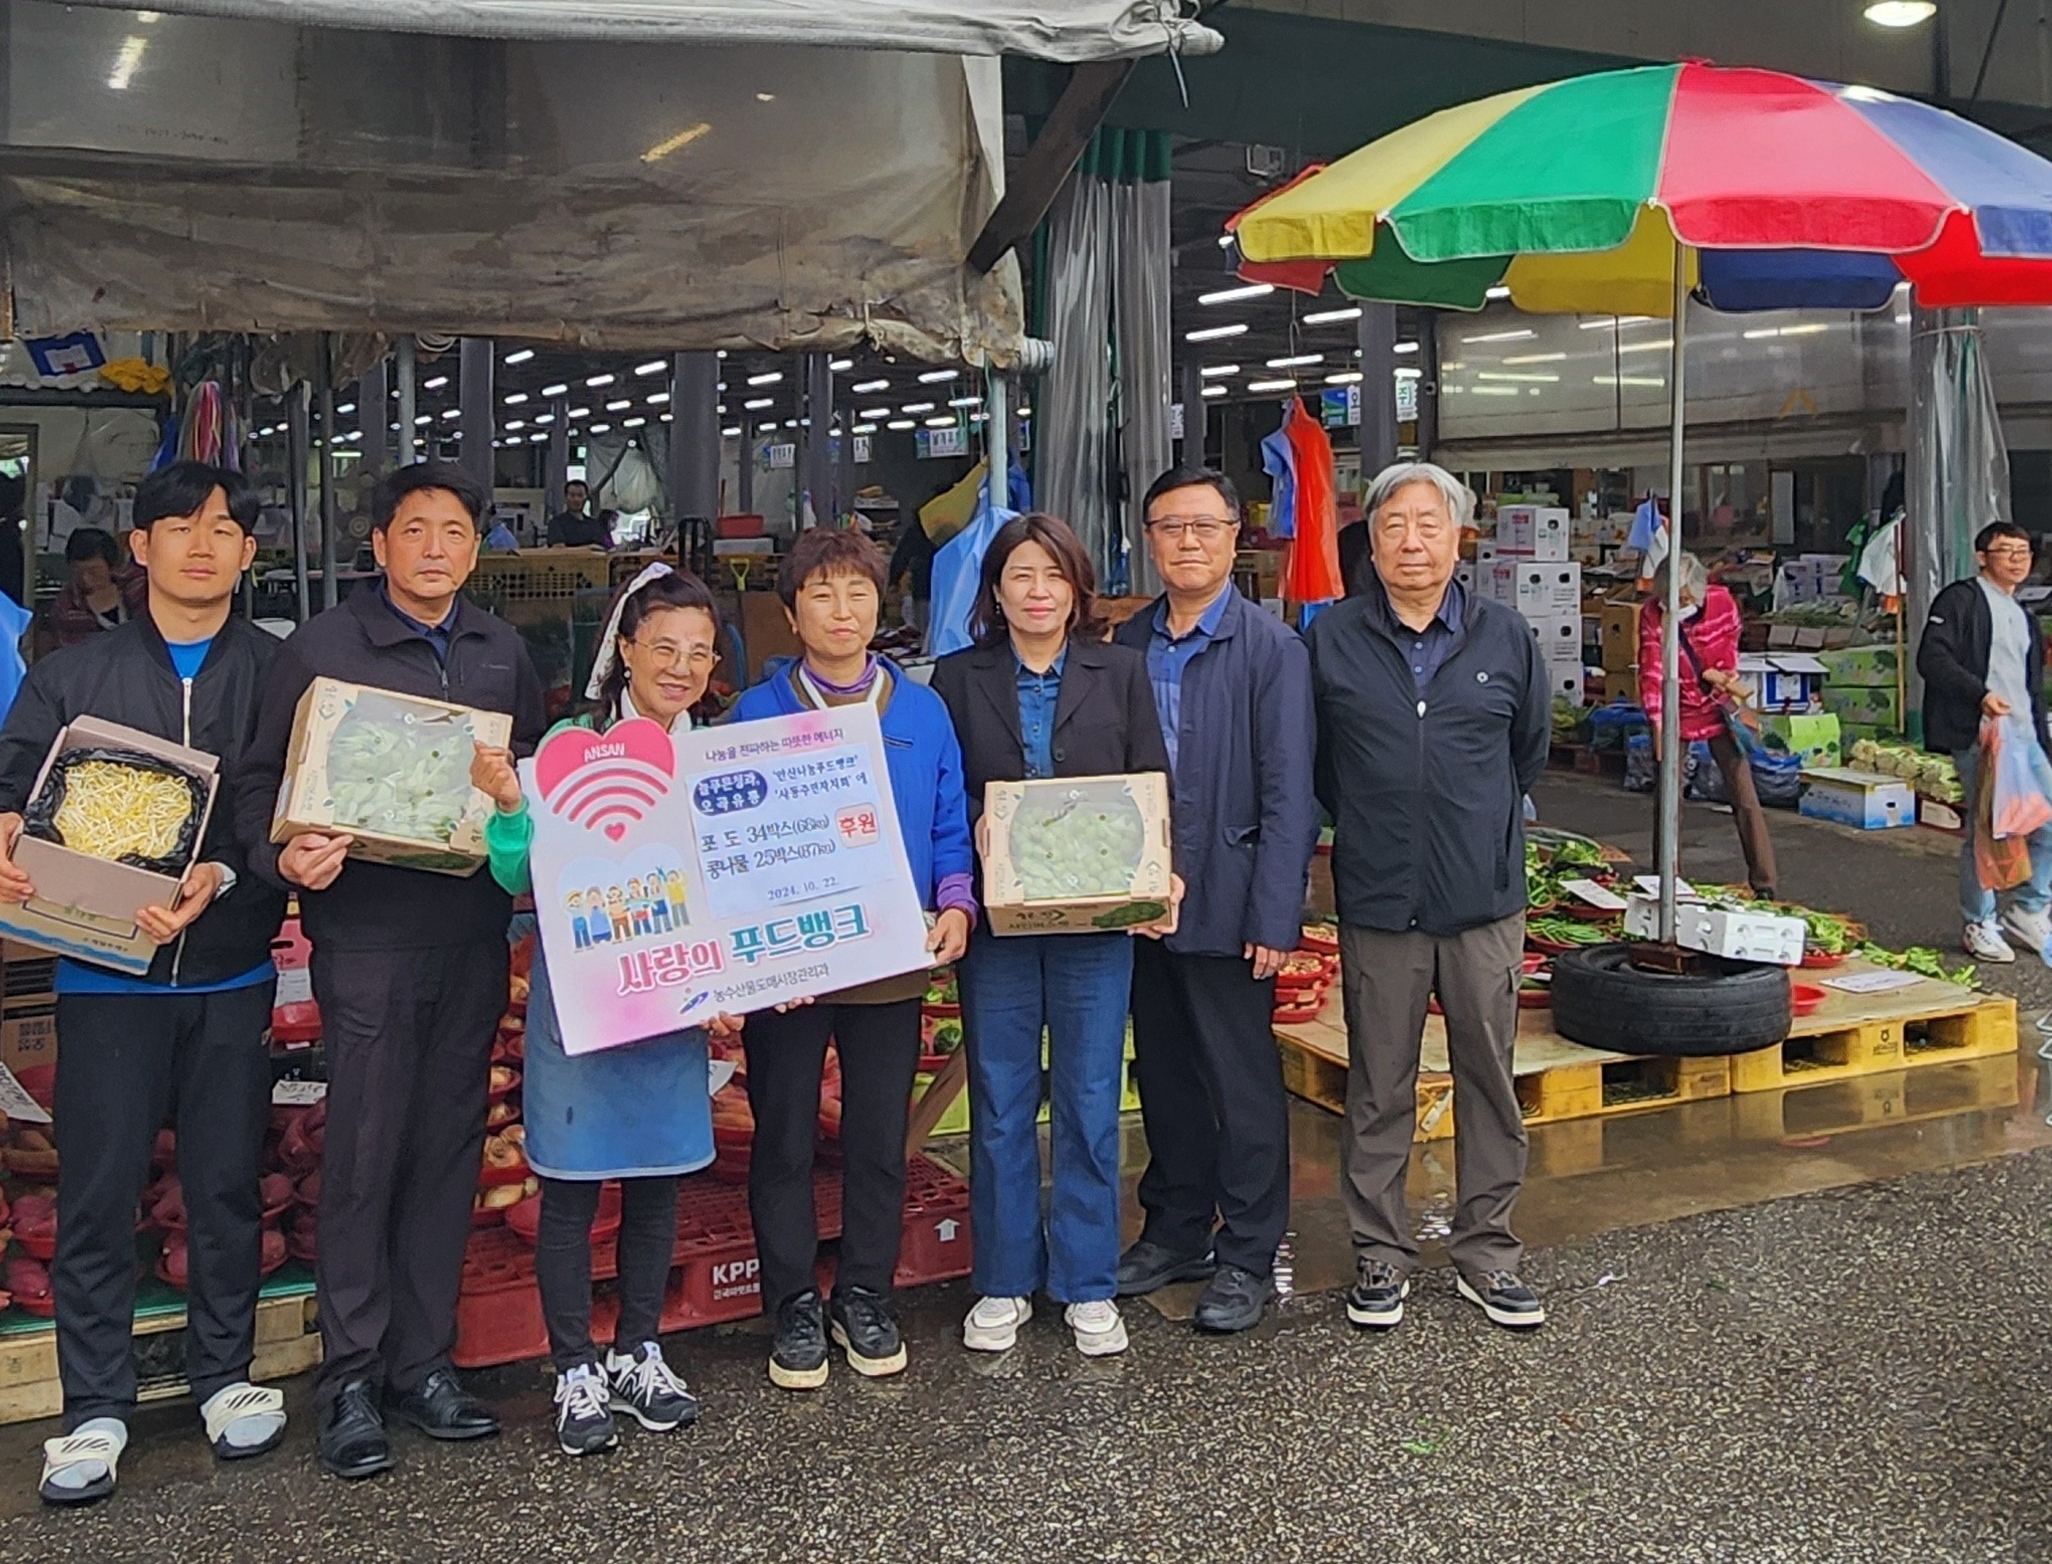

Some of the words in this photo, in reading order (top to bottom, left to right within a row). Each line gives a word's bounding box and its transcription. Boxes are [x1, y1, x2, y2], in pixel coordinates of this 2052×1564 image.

[584, 742, 625, 763] ANSAN
[705, 747, 737, 762] 나눔을
[739, 740, 780, 757] 전파하는
[782, 733, 812, 748] 따뜻한
[813, 728, 844, 743] 에너지
[838, 812, 877, 838] 후원
[706, 853, 749, 880] 콩나물
[767, 886, 799, 900] 2024.
[619, 940, 722, 992] 사랑의
[730, 904, 869, 964] 푸드뱅크
[712, 962, 830, 1003] 농수산물도매시장관리과
[713, 1258, 760, 1286] KPP
